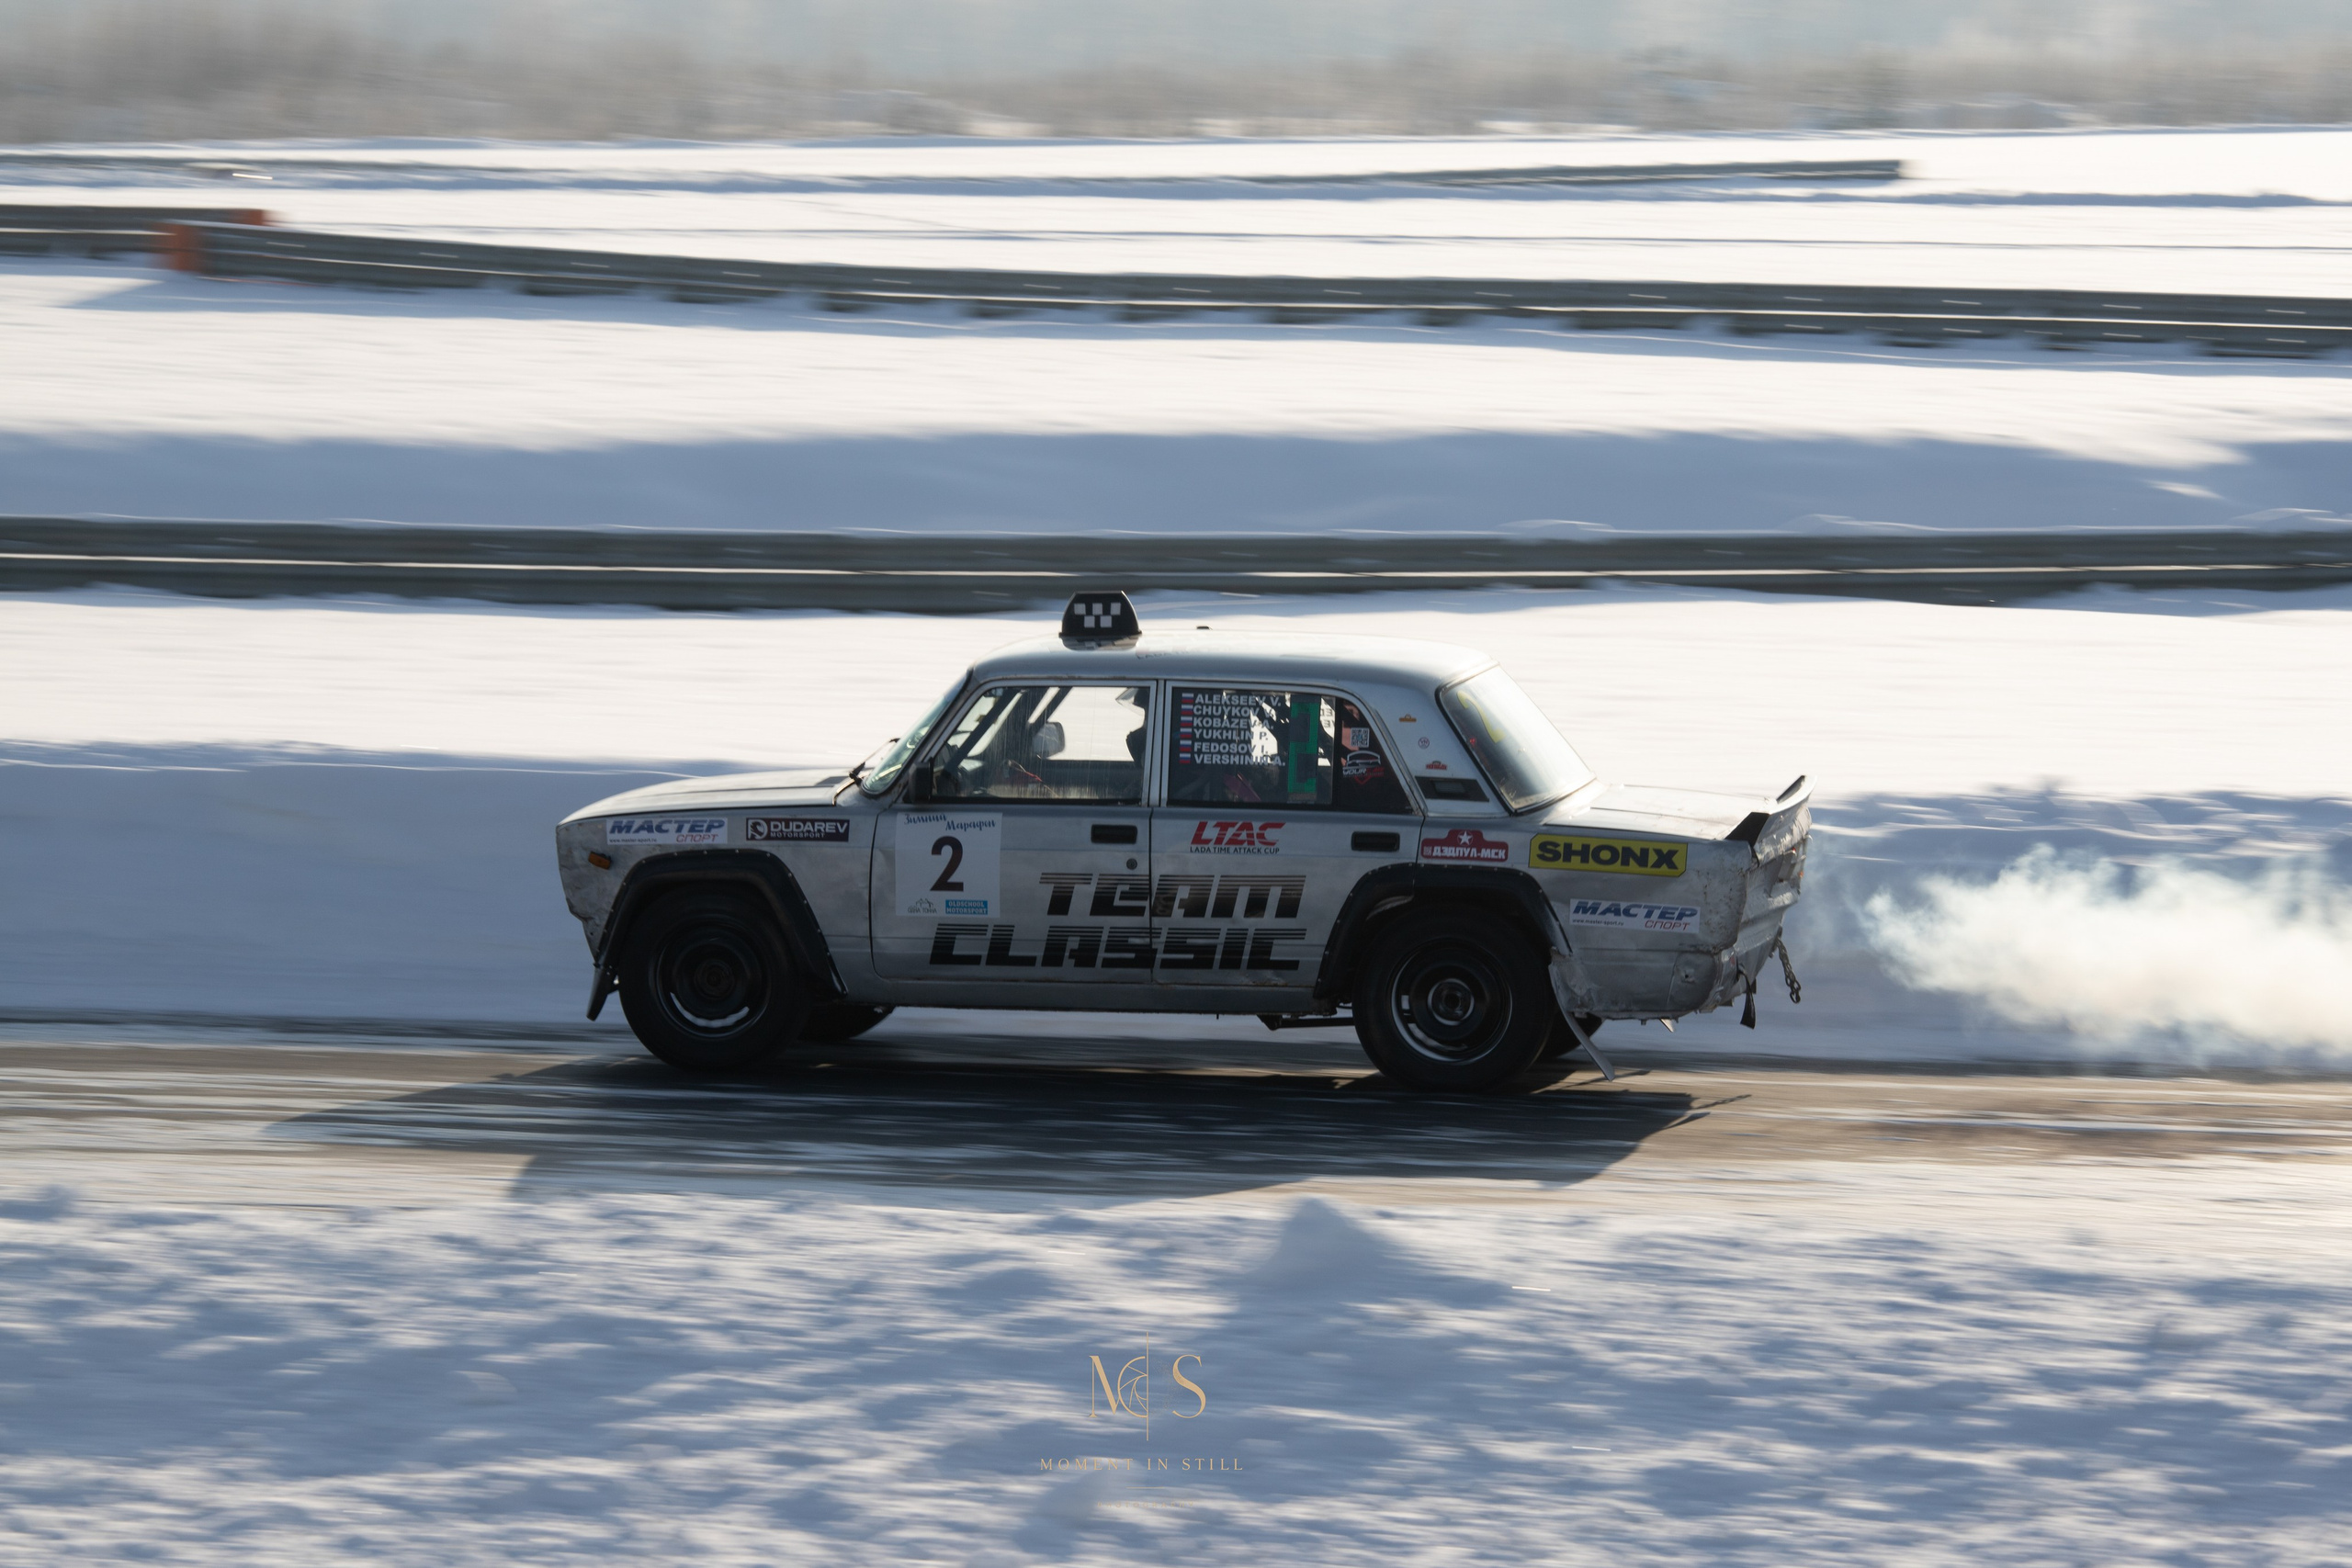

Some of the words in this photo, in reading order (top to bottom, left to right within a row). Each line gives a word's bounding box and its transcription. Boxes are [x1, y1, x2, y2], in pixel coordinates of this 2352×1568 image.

[1195, 694, 1267, 706] ALEKSEEV
[1270, 696, 1281, 706] V.
[1193, 705, 1260, 717] CHUYKOV
[1193, 717, 1257, 728] KOBAZEV
[1193, 729, 1253, 740] YUKHLIN
[1260, 731, 1268, 740] P.
[1193, 742, 1257, 753] FEDOSOV
[1194, 754, 1269, 765] VERSHININ
[609, 819, 725, 833] МАСТЕР
[770, 821, 848, 833] DUDAREV
[676, 834, 718, 842] СПОРТ
[1191, 821, 1286, 846] LTAC
[1234, 846, 1262, 854] ATTACK
[1432, 846, 1506, 859] ДЭДПУЛ-МСК
[1536, 841, 1679, 870] SHONX
[930, 836, 964, 892] 2
[1039, 873, 1306, 919] TEAM
[1573, 901, 1698, 920] МАСТЕР
[1645, 920, 1690, 931] СПОРТ
[929, 924, 1306, 970] CLASSIC
